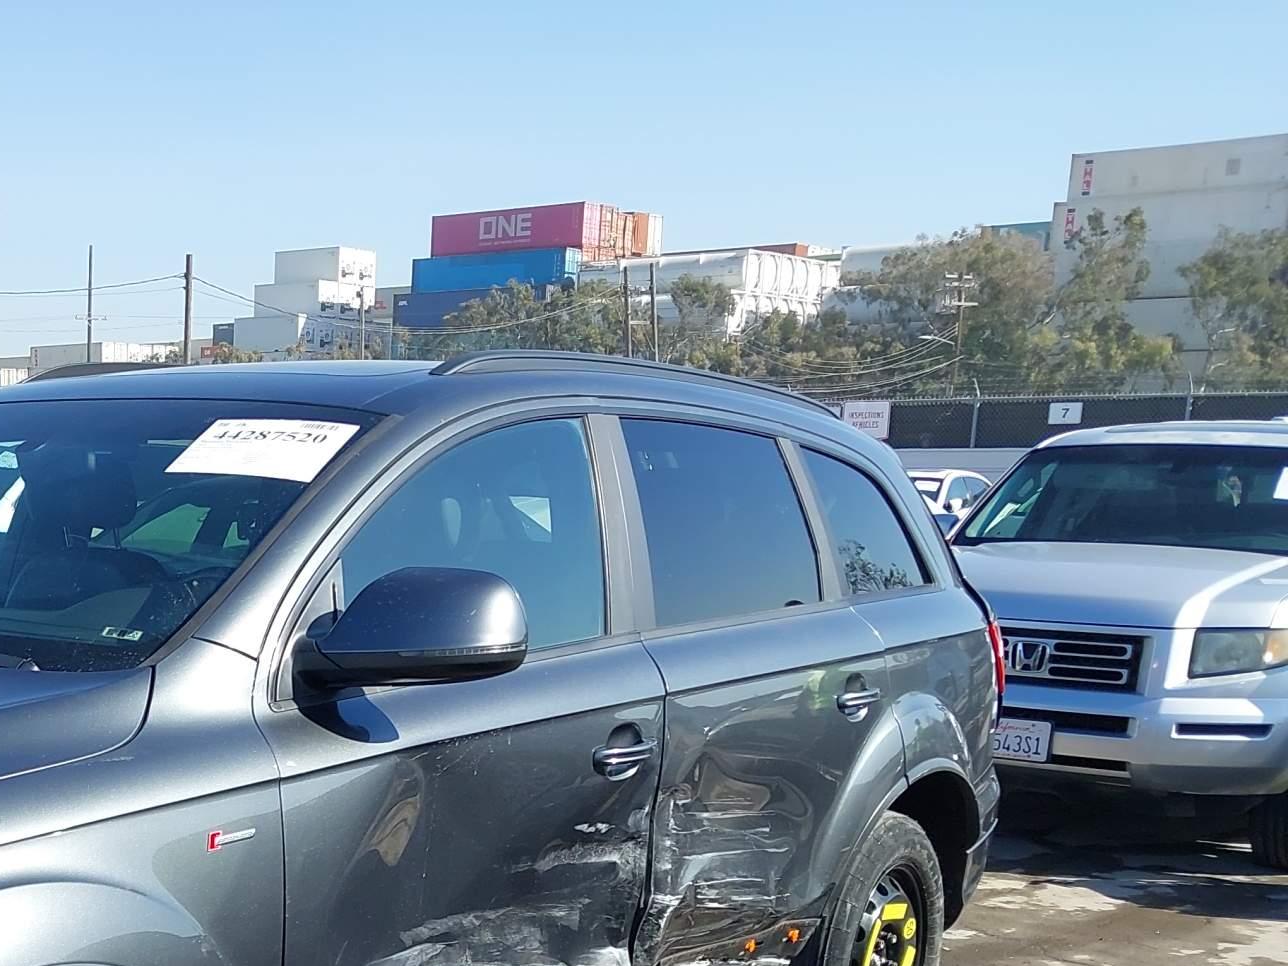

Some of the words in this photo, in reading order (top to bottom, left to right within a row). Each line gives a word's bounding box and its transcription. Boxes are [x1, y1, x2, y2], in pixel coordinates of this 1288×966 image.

[479, 212, 532, 240] ONE
[1061, 407, 1071, 418] 7
[212, 429, 328, 446] 44287520
